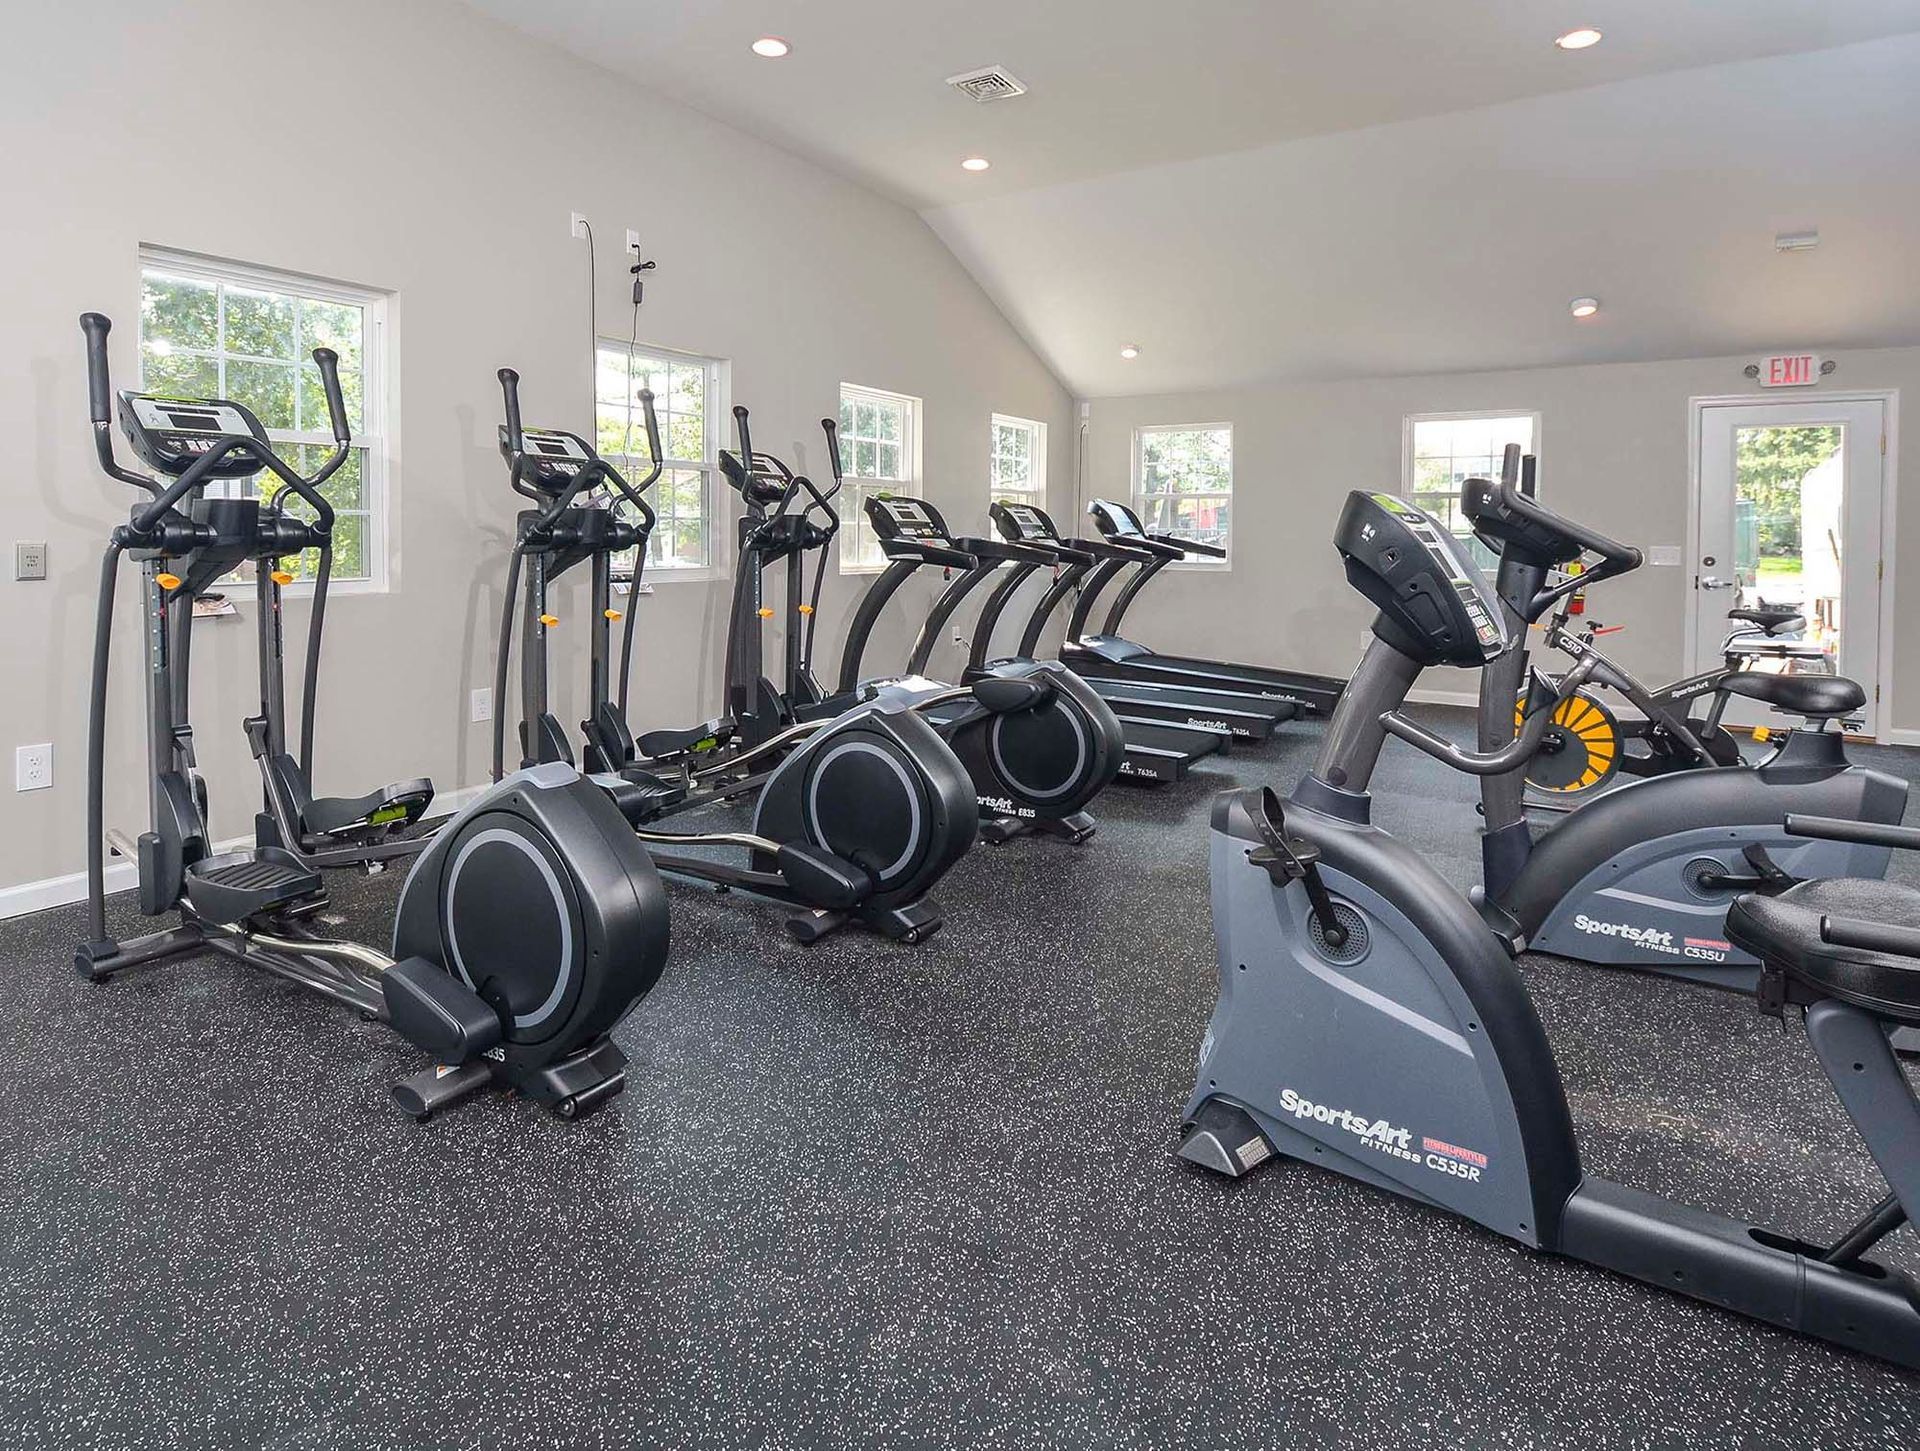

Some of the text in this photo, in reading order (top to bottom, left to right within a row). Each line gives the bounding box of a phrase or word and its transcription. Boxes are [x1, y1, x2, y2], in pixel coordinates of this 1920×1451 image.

[1769, 356, 1813, 384] EXIT
[1560, 636, 1583, 654] C510
[1137, 767, 1158, 778] T635A
[976, 796, 1013, 810] ortsArt
[1018, 807, 1036, 818] E835
[1574, 914, 1674, 946] SportsArt
[1634, 940, 1680, 955] FITNESS
[1684, 946, 1725, 962] C535U
[483, 1047, 506, 1062] 835
[1279, 1088, 1413, 1150] SportsArt
[1360, 1136, 1422, 1164] FITNESS
[1425, 1153, 1481, 1183] C535R
